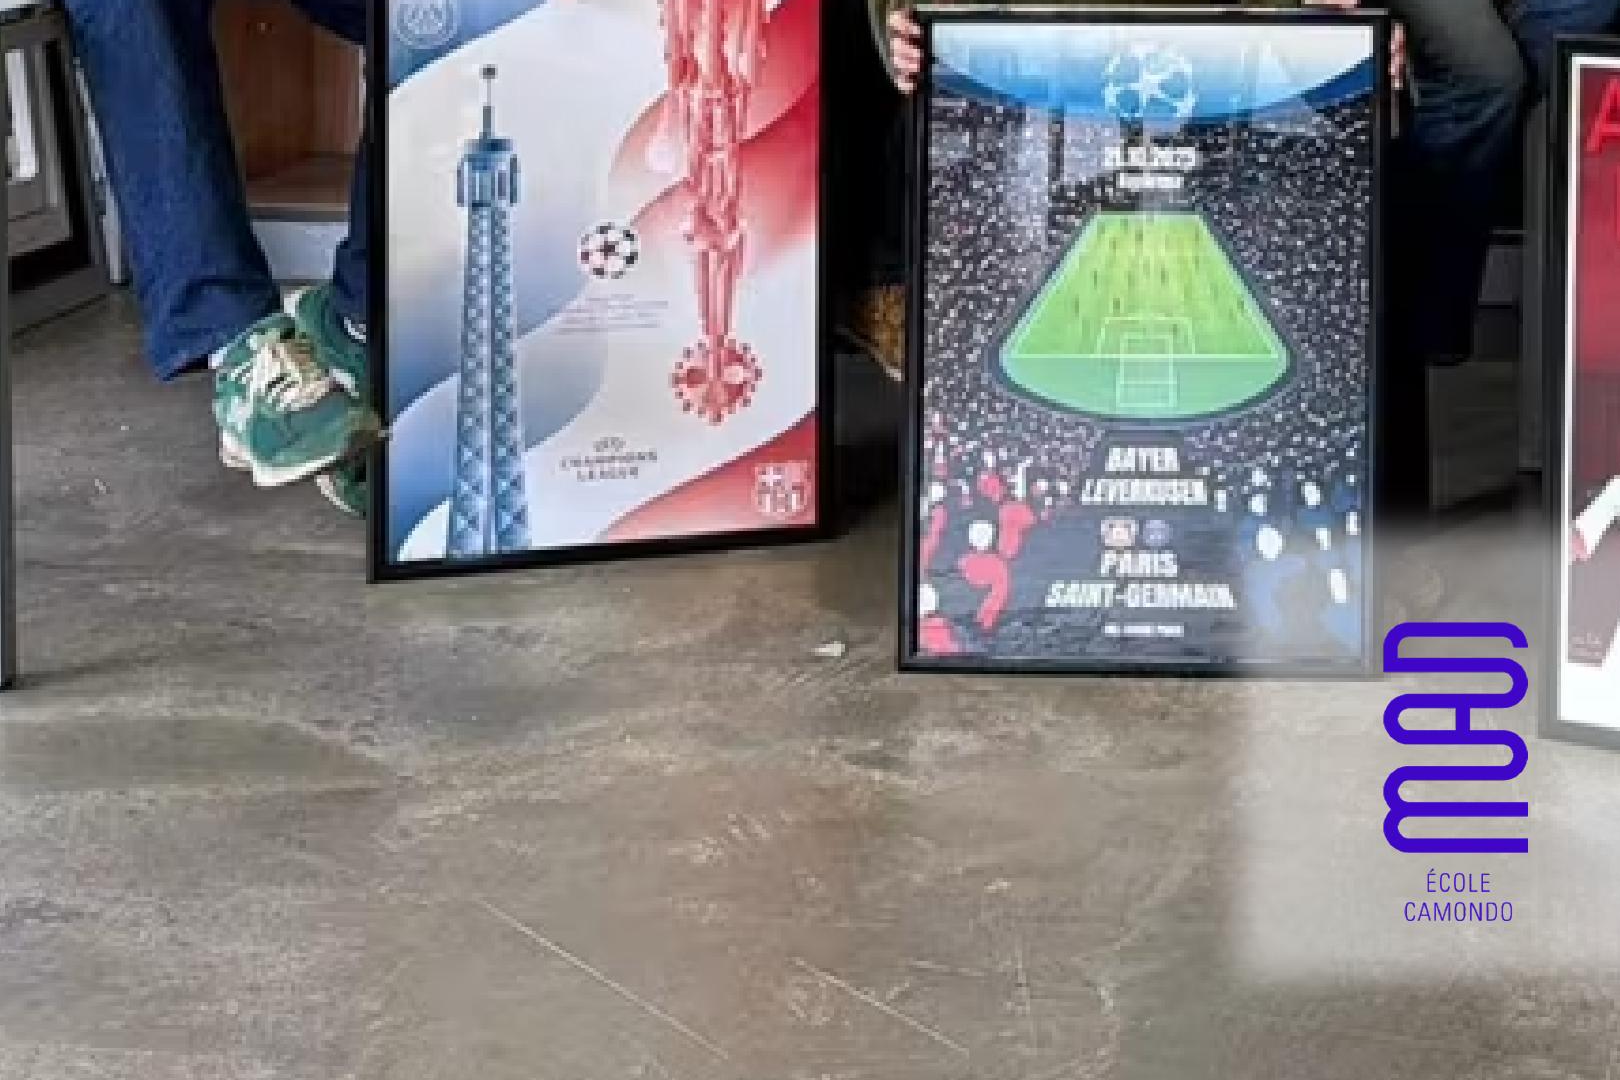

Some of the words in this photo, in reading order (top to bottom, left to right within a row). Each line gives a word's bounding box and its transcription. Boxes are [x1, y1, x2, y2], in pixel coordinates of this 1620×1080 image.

[1104, 447, 1180, 472] BAYER
[1081, 478, 1208, 506] LEVERKUSEN
[1100, 550, 1178, 578] PARIS
[1044, 581, 1236, 610] SAINT-GERMAIN
